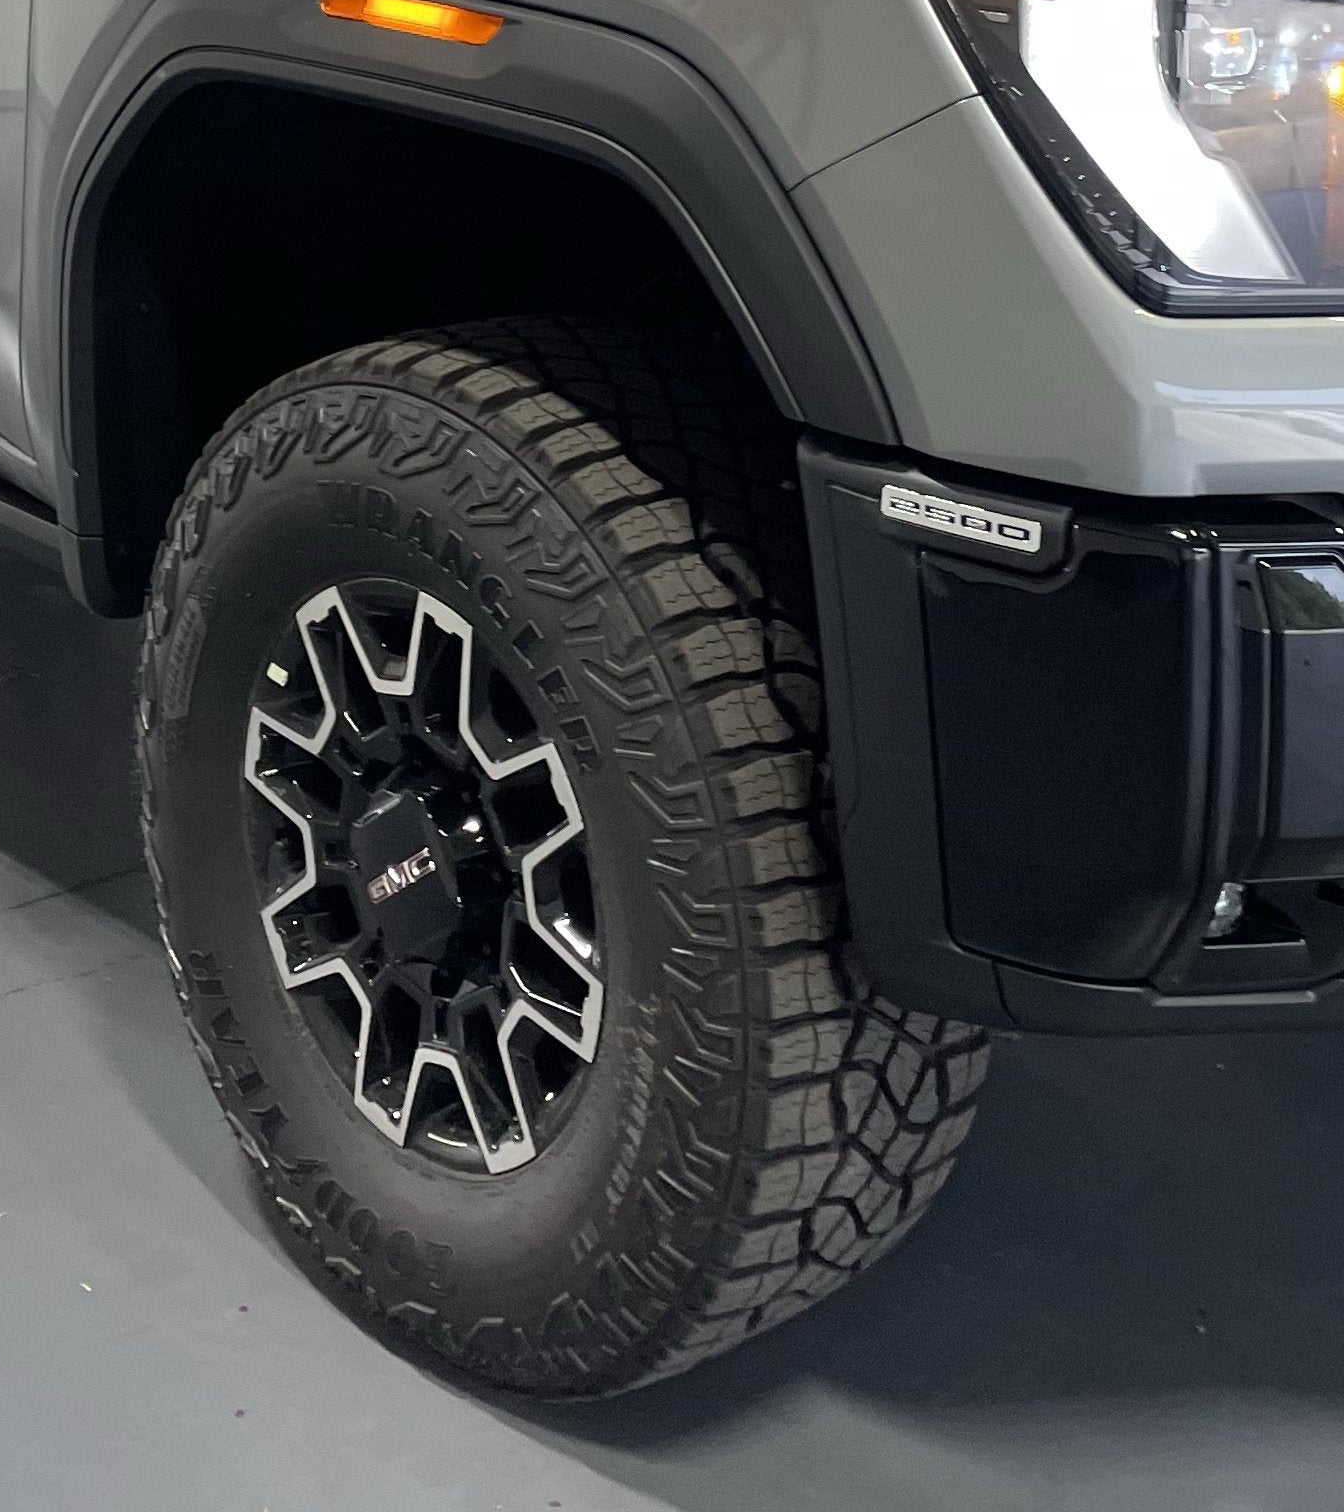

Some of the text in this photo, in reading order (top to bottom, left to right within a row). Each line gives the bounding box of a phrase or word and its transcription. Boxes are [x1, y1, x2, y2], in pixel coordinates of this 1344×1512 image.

[888, 496, 1031, 543] 2500
[316, 478, 603, 776] WRANGLER
[366, 846, 436, 905] GMC
